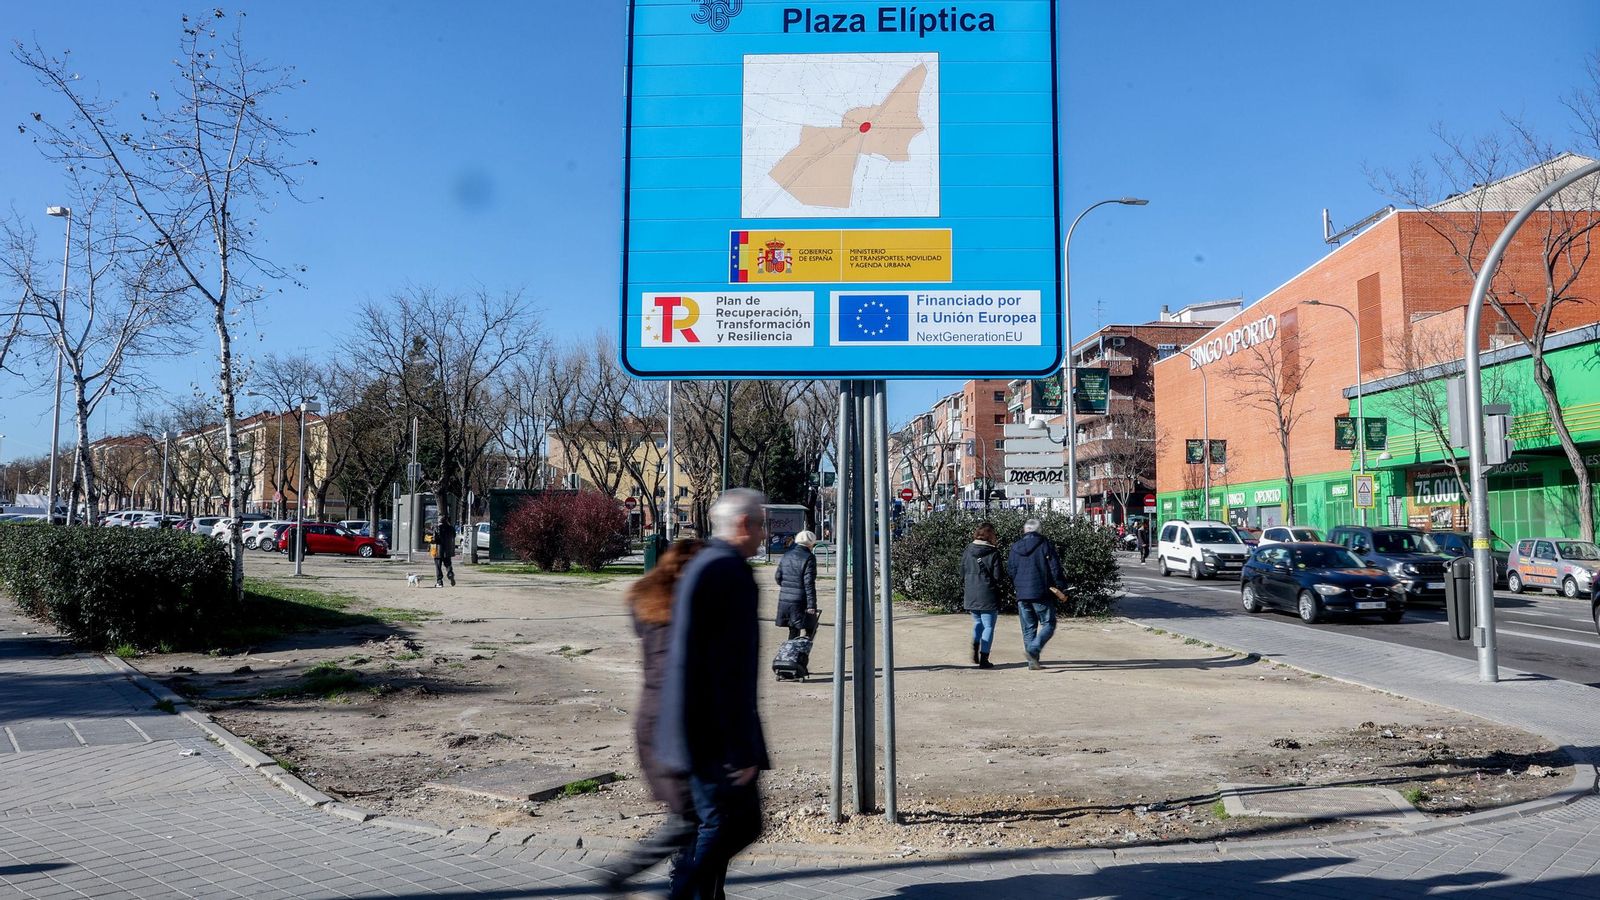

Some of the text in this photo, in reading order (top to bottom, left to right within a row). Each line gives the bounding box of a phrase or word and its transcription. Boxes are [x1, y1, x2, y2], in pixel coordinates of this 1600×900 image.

[783, 7, 995, 38] Plaza Elíptica
[809, 254, 833, 262] ESPAÑA
[716, 296, 760, 305] Plan de
[917, 295, 1021, 308] Financiado por
[716, 307, 802, 318] Recuperación,
[916, 311, 1037, 325] la Unión Europea
[716, 319, 811, 329] Transformación
[717, 331, 793, 342] y Resiliencia
[917, 331, 1023, 342] NextGenerationEU
[1190, 314, 1277, 370] BINGO OPORTO
[1414, 478, 1460, 504] 75.000
